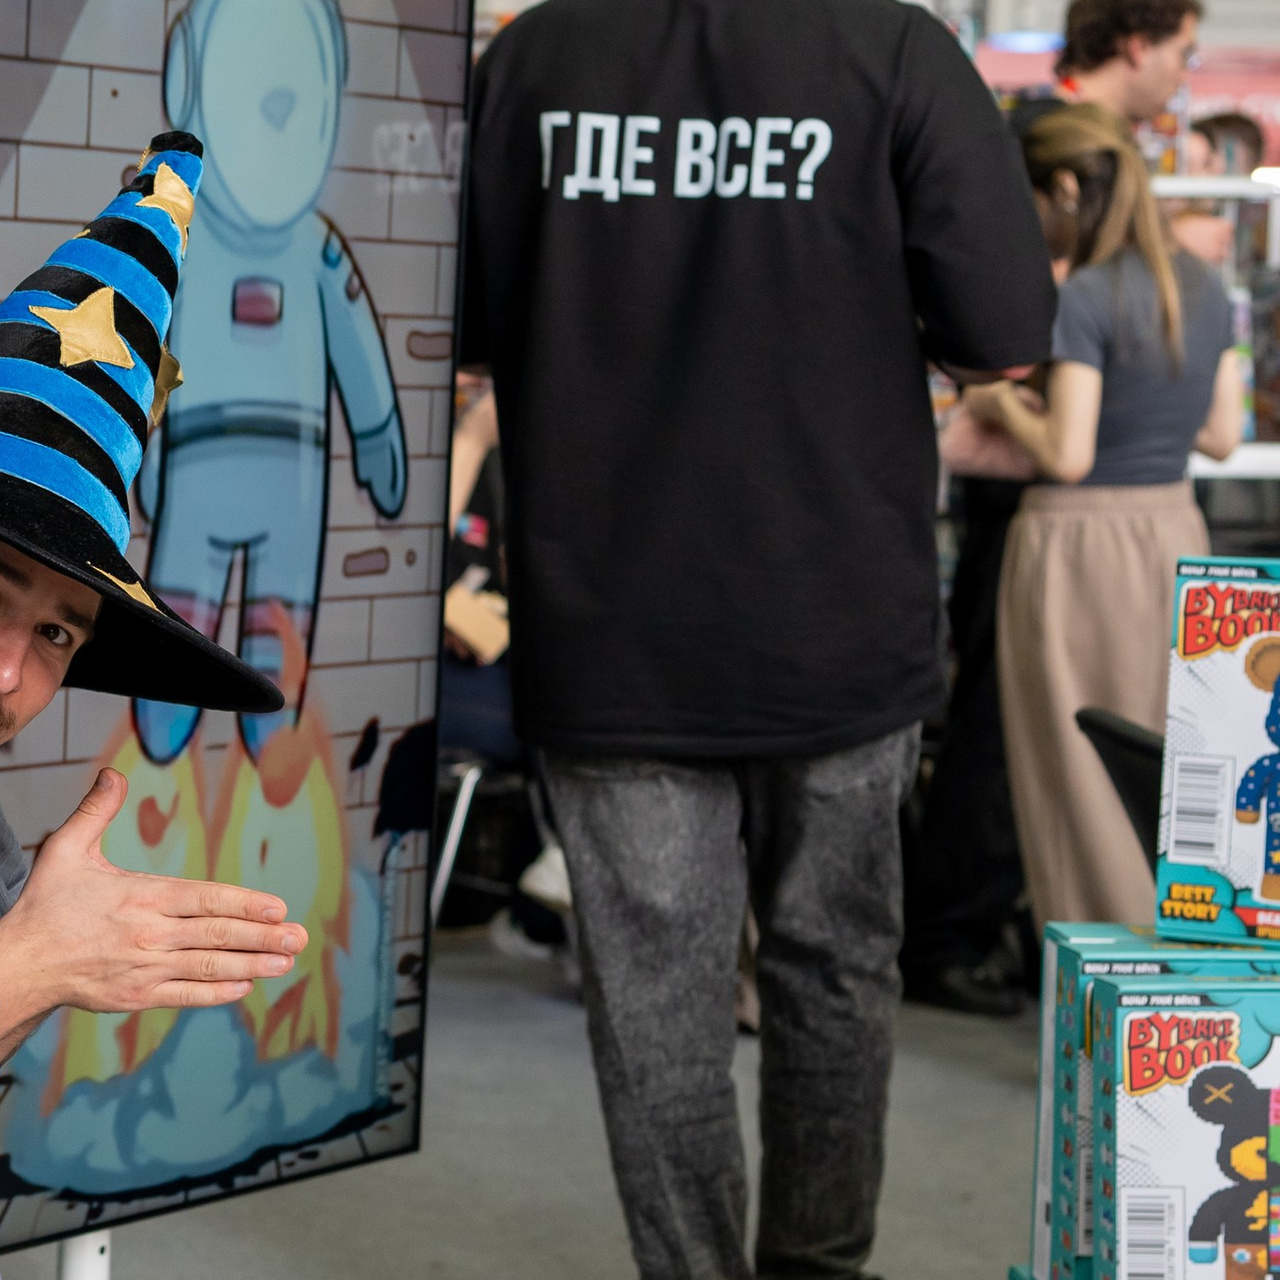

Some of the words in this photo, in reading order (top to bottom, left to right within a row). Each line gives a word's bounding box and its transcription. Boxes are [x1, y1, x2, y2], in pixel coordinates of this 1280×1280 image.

[540, 111, 661, 202] ГДЕ
[674, 116, 833, 200] ВСЕ?
[1161, 900, 1221, 923] STORY
[1130, 1040, 1233, 1090] BOOK
